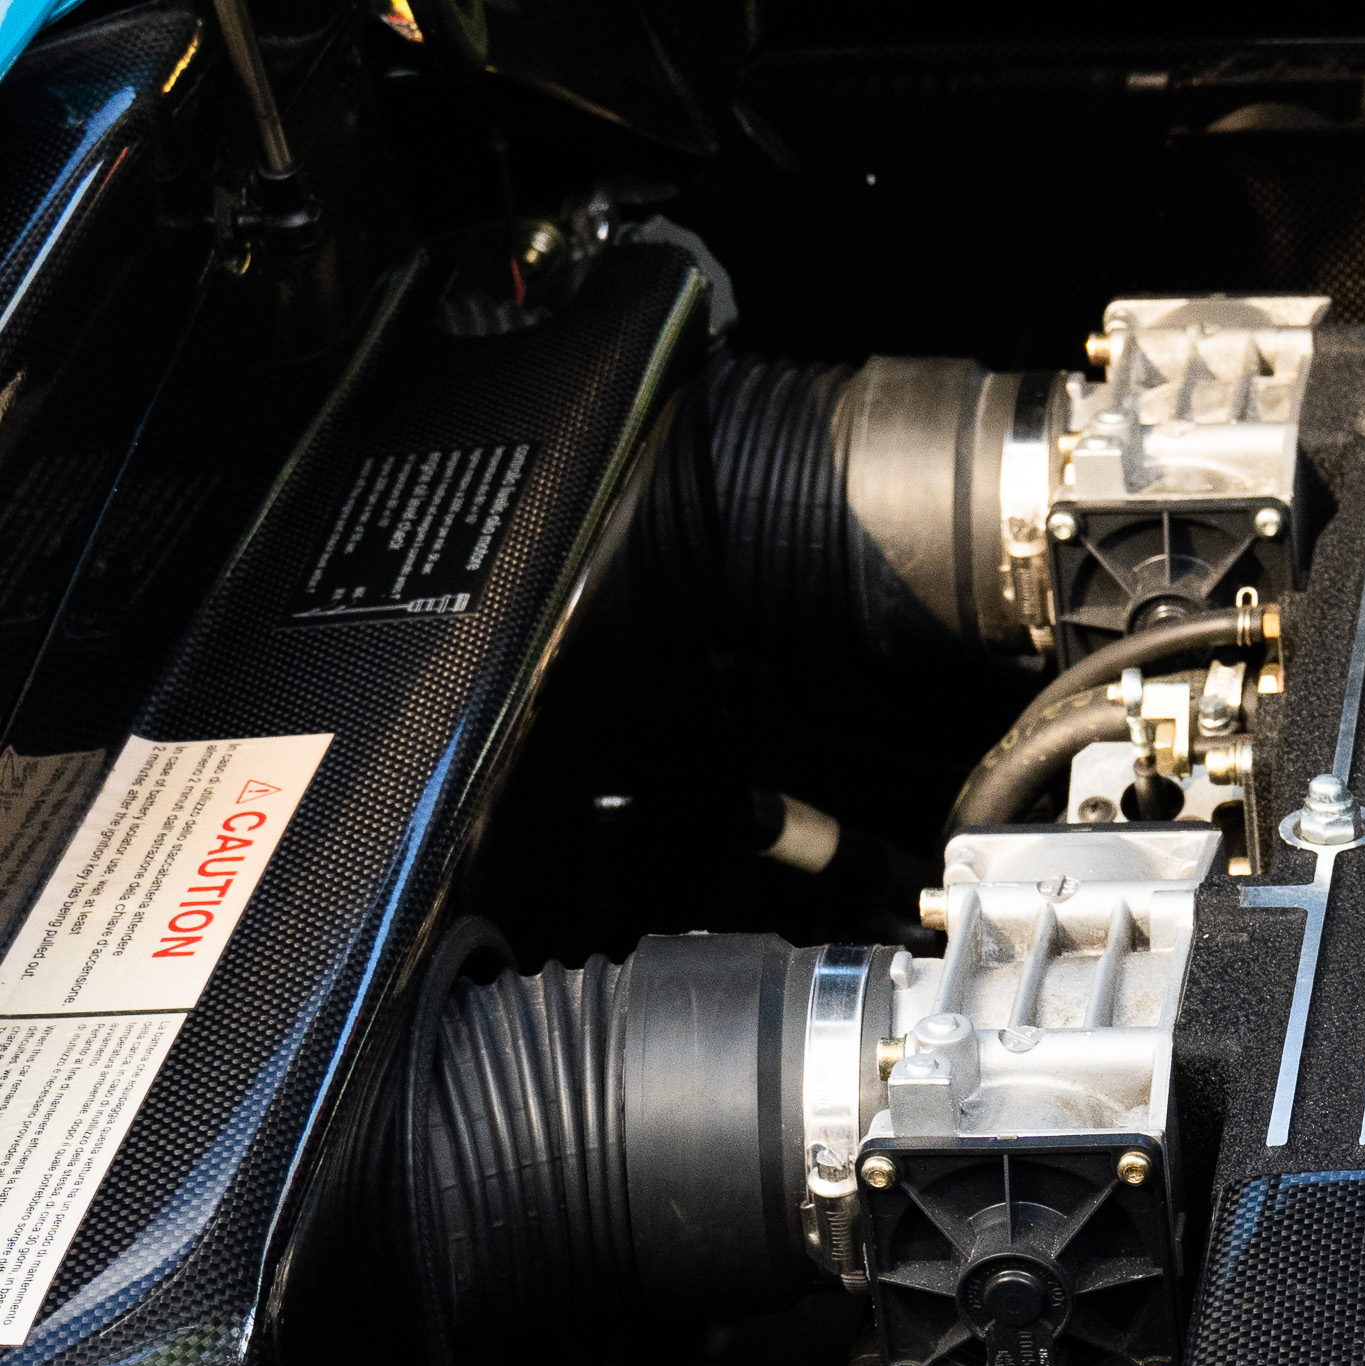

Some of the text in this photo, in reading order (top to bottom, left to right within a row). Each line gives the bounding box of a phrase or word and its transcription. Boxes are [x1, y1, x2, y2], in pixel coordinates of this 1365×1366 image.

[130, 752, 159, 786] minutes
[191, 743, 217, 776] almeno
[212, 752, 233, 774] caso
[207, 775, 220, 785] di
[119, 788, 139, 811] after
[171, 784, 194, 812] minuti
[188, 786, 213, 817] utilizzo
[109, 811, 128, 827] the
[175, 818, 196, 842] dello
[68, 745, 187, 935] In case of battery isolator use, wait at least
[89, 827, 115, 862] ignition
[133, 813, 178, 879] dall'estrazione
[75, 862, 99, 880] key
[137, 842, 183, 909] staccabatteria
[153, 810, 266, 958] CAUTION
[66, 881, 88, 899] has
[118, 880, 140, 901] della
[47, 900, 75, 928] being
[100, 902, 126, 937] chiave
[32, 928, 58, 959] pulled
[111, 910, 145, 956] attendere
[19, 960, 39, 980] out.
[62, 938, 108, 1004] d'accensione.
[0, 1025, 21, 1052] charge
[77, 1022, 106, 1056] Pertanto
[88, 1022, 119, 1067] avviamento.
[103, 1021, 136, 1069] temperatura
[135, 1020, 152, 1040] della
[0, 1024, 37, 1081] difficulties, we
[55, 1032, 80, 1067] inutilizzo
[73, 1057, 84, 1065] al
[121, 1040, 141, 1066] carica,
[0, 1024, 54, 1111] When this car remains
[63, 1065, 81, 1081] fine
[115, 1068, 126, 1077] in
[26, 1074, 58, 1119] necessario
[58, 1082, 70, 1091] di
[78, 1070, 109, 1114] ambientale,
[103, 1077, 121, 1098] caso
[33, 1092, 64, 1136] mantenere
[99, 1099, 110, 1108] di
[64, 1117, 83, 1140] dopo
[78, 1108, 104, 1145] inutilizzo
[0, 1119, 32, 1166] provvedere
[11, 1136, 39, 1175] efficiente
[65, 1146, 84, 1167] della
[2, 1019, 170, 1326] La batteria che equipaggia questa vettura ha un periodo di mantenimento
[47, 1147, 66, 1172] quale
[5, 1176, 18, 1185] la
[48, 1168, 72, 1199] stessa,
[20, 1172, 53, 1221] potrebbero
[30, 1210, 50, 1232] circa
[1, 1222, 26, 1256] sorgere
[24, 1234, 40, 1246] 30
[8, 1246, 30, 1275] giorni,
[3, 1276, 15, 1286] in
